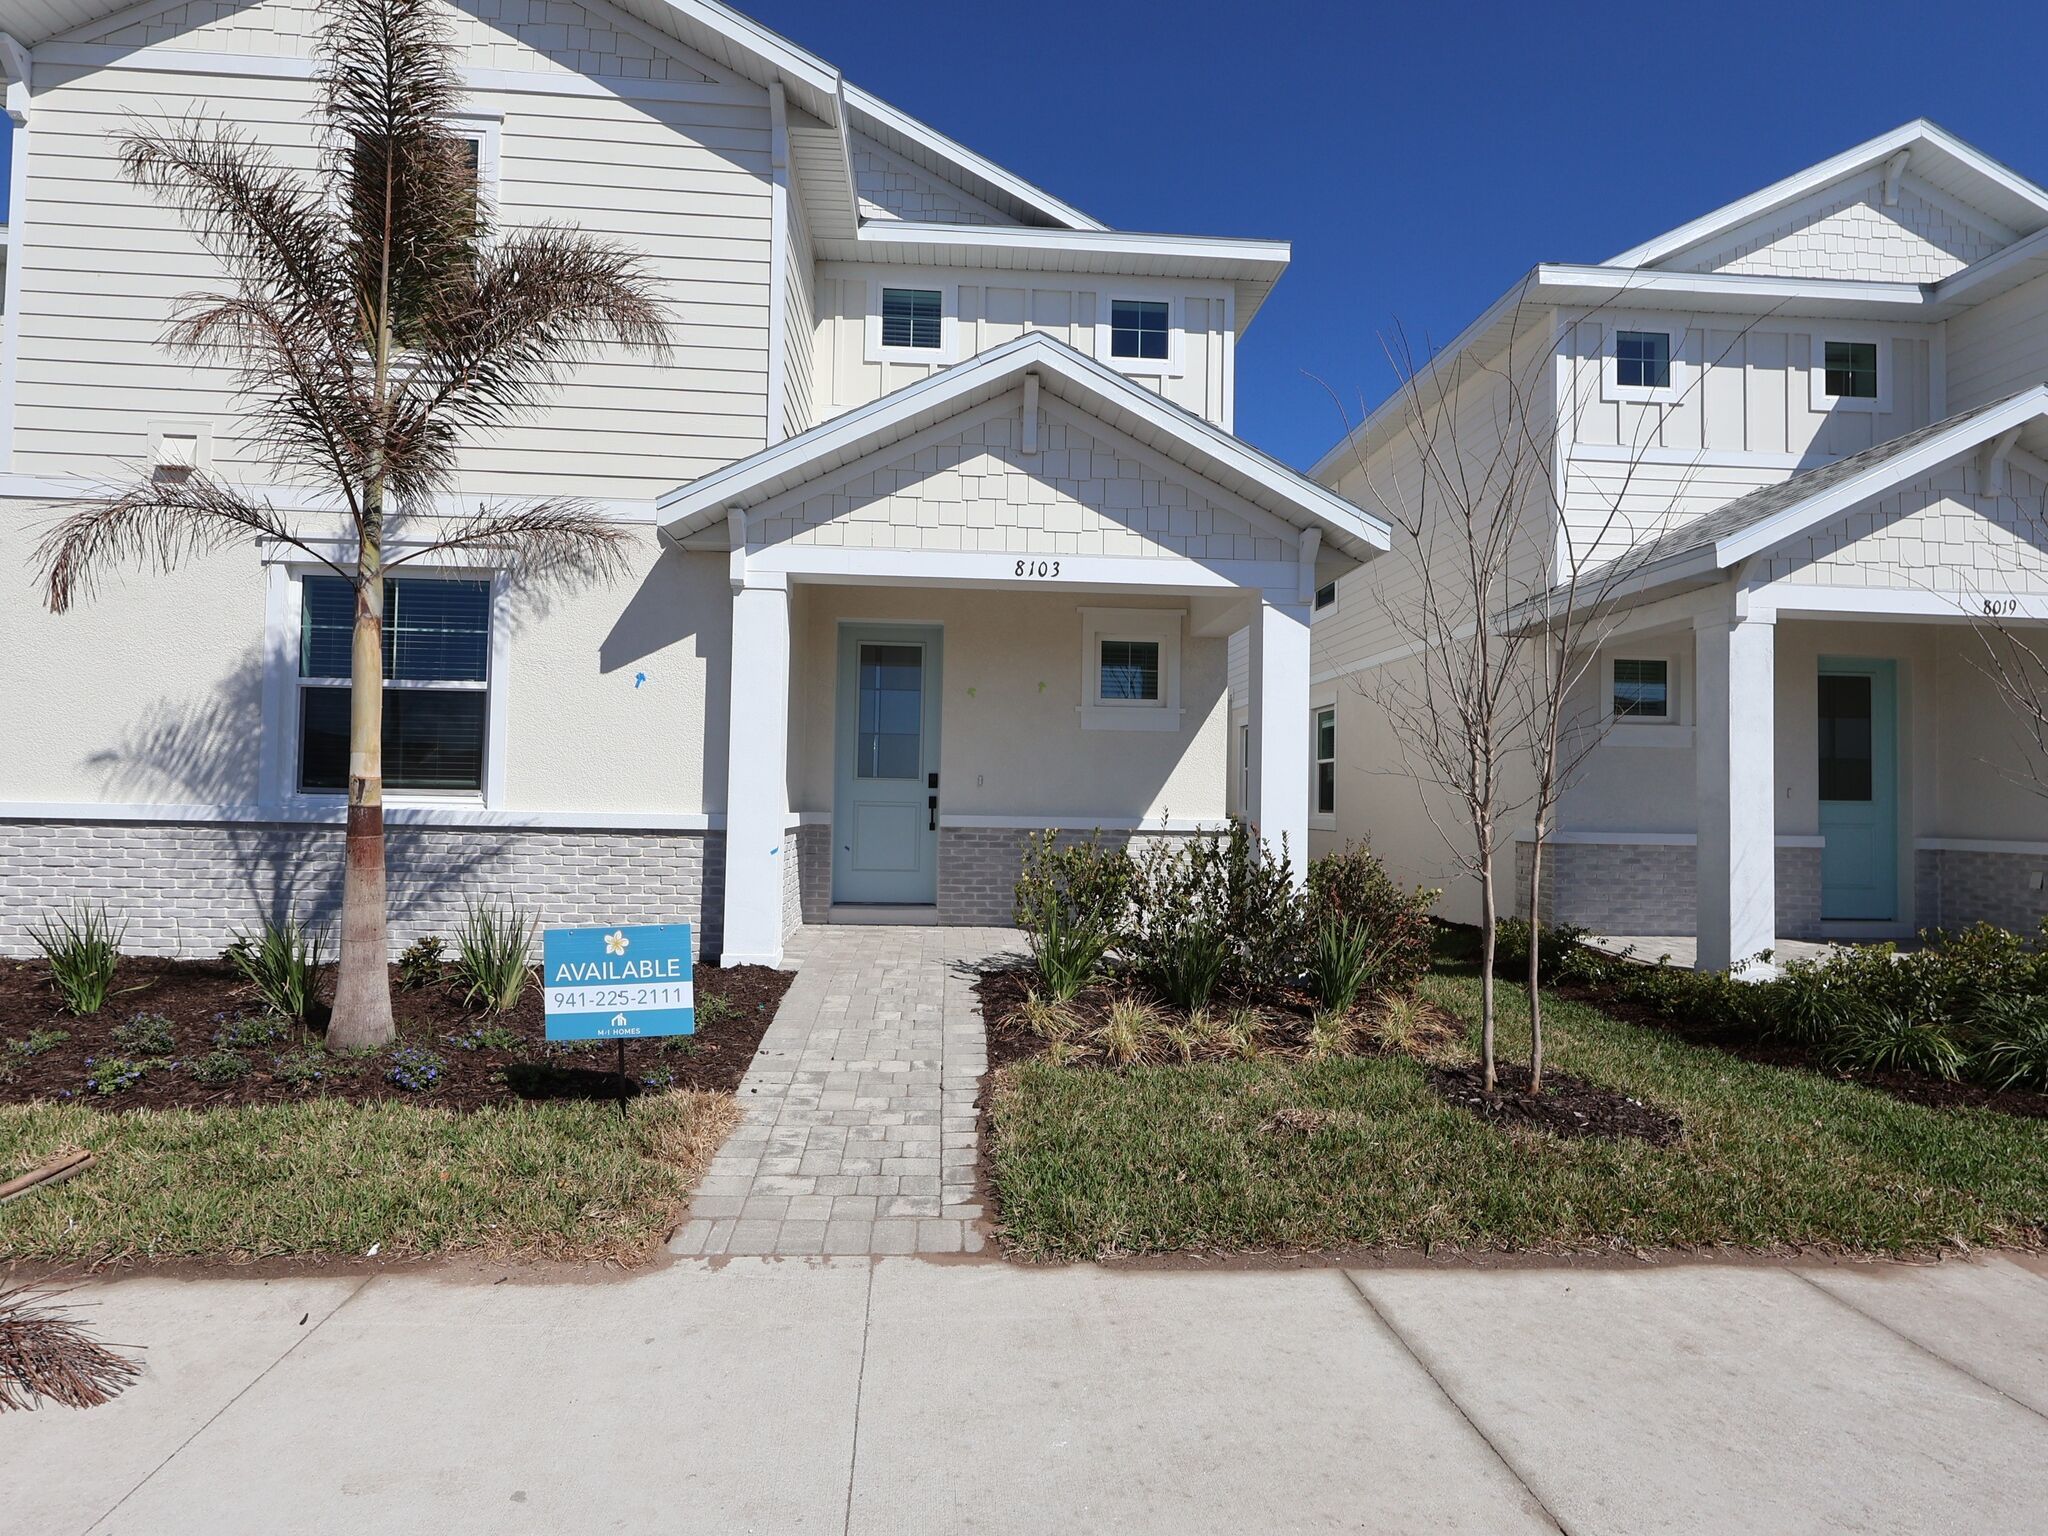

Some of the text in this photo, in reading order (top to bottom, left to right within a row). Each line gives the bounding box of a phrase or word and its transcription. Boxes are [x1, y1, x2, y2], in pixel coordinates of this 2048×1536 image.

[1015, 560, 1060, 578] 8103
[1983, 599, 2017, 615] 8019
[555, 959, 681, 982] AVAILABLE
[554, 988, 681, 1008] 941-225-2111
[613, 1027, 641, 1035] HOMES
